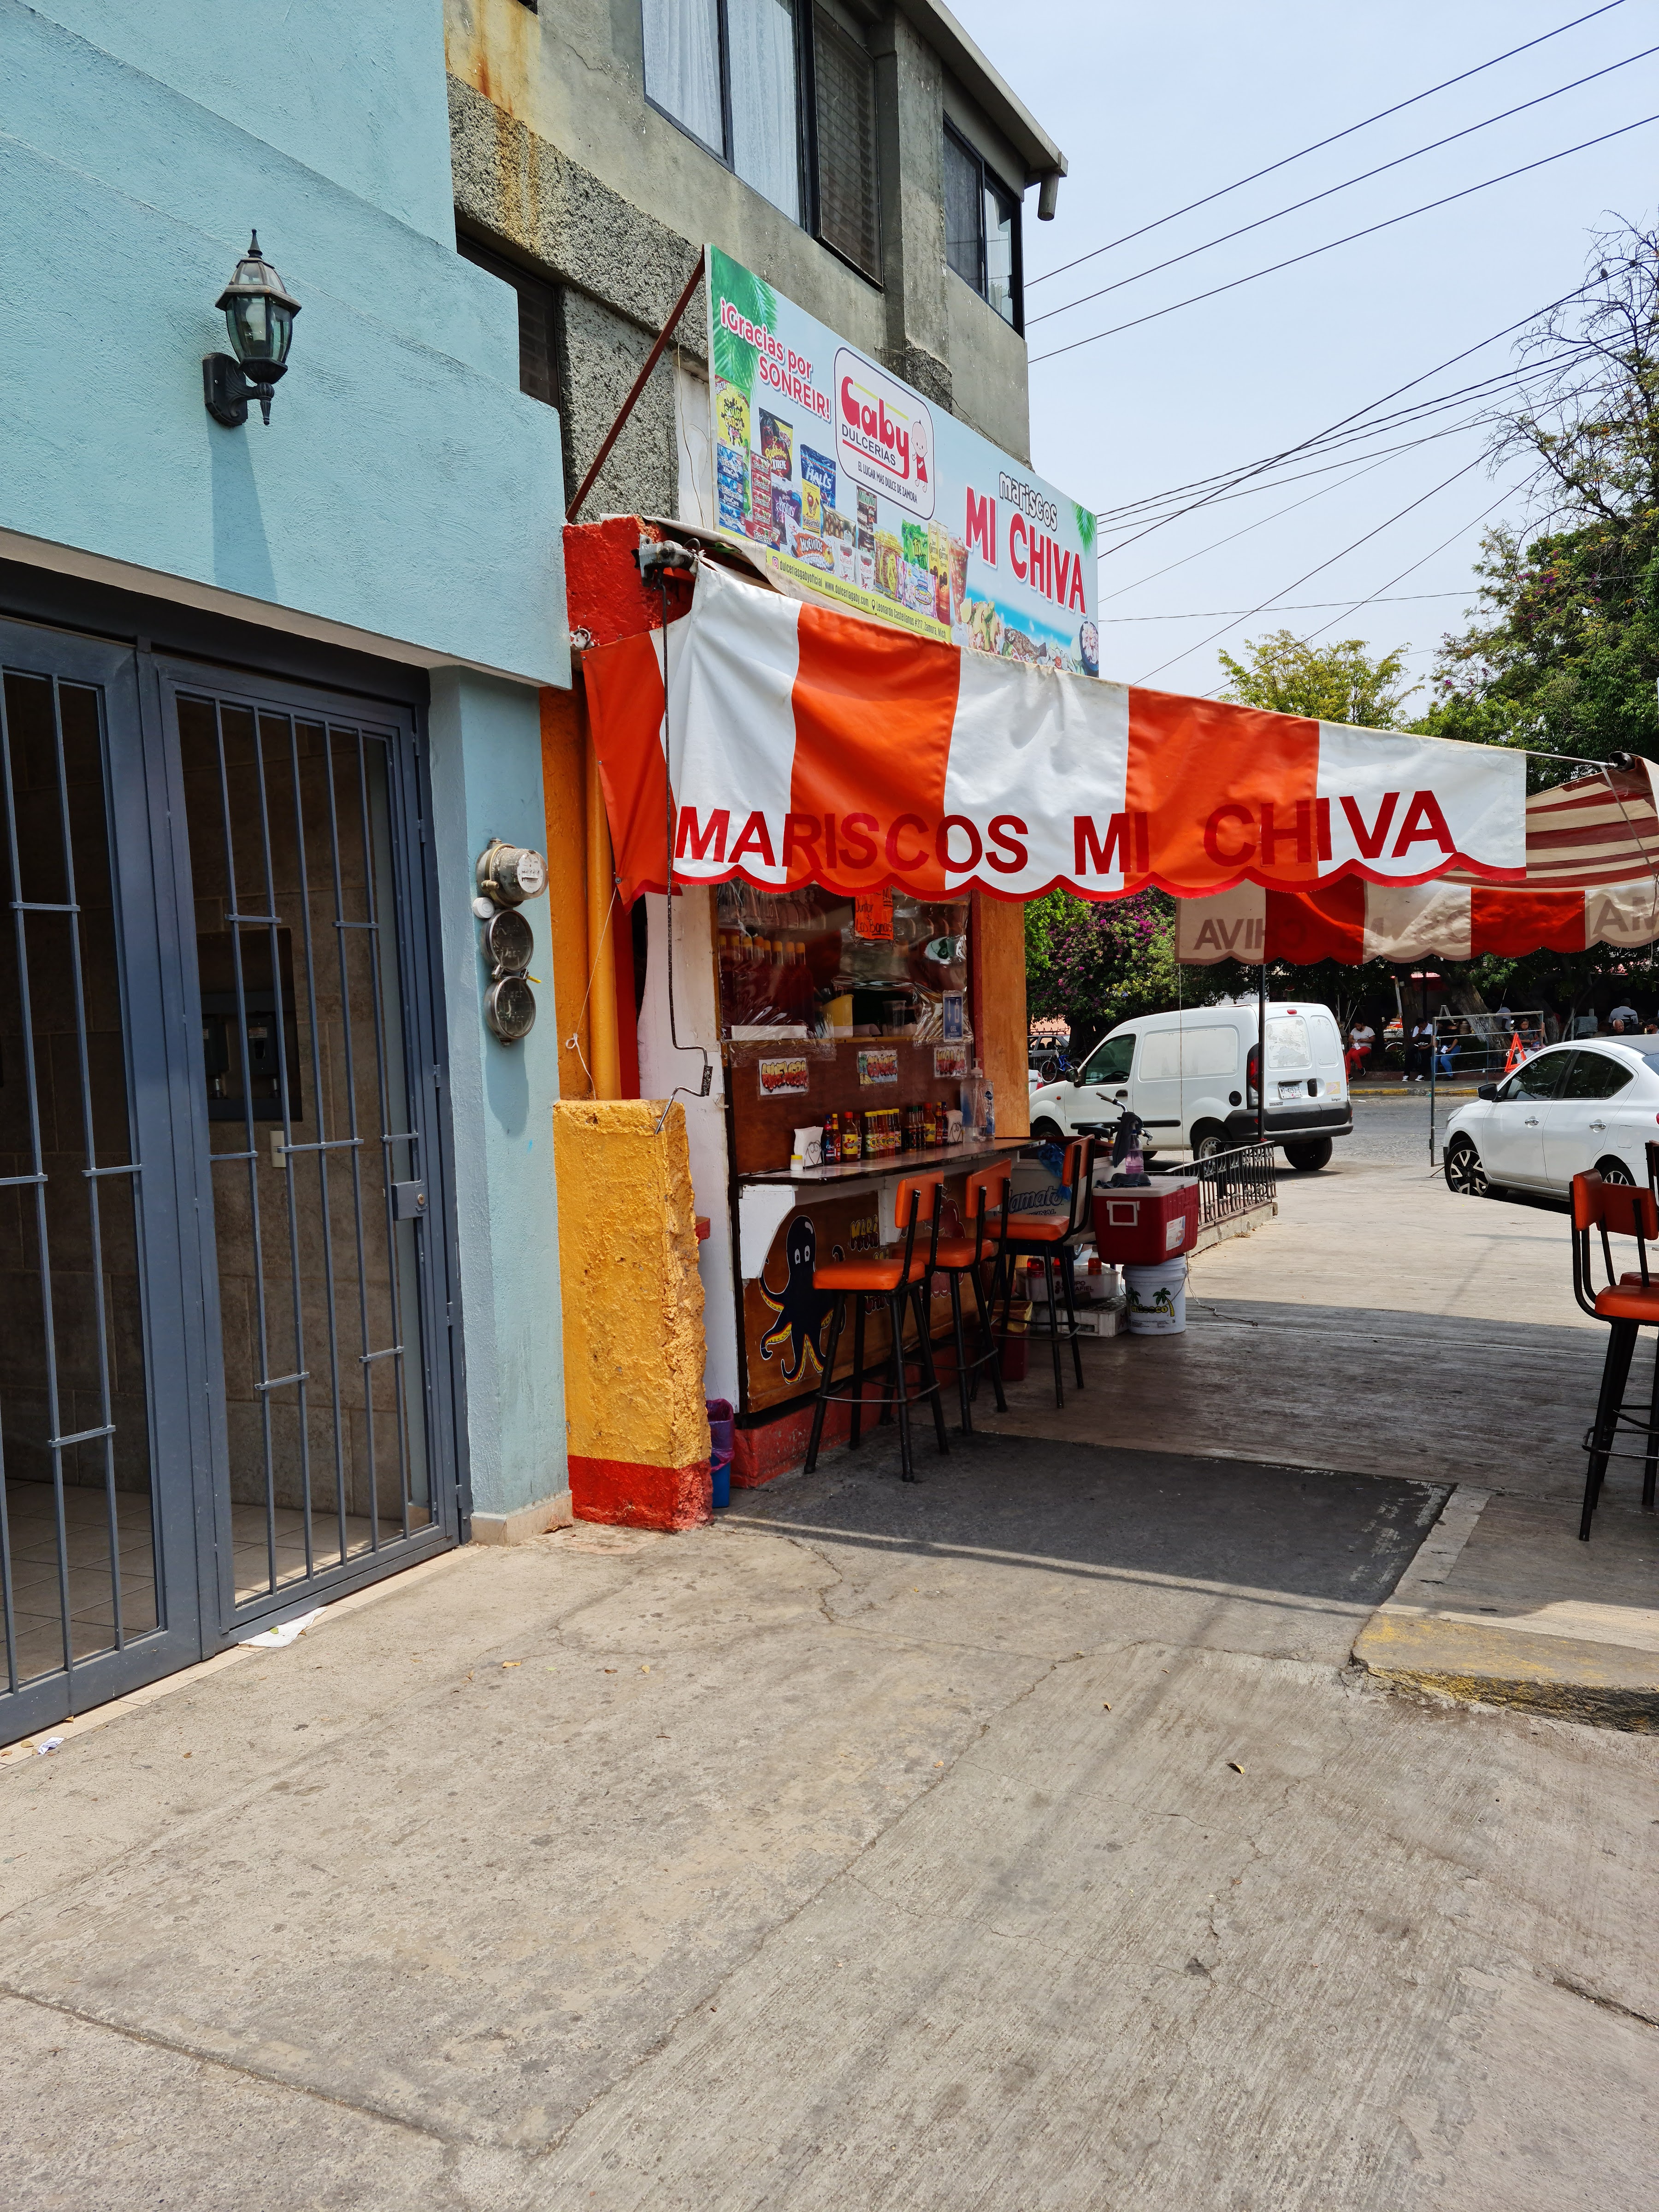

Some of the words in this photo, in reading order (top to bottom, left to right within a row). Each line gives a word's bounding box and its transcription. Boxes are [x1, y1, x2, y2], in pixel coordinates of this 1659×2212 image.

[720, 297, 784, 361] ¡Gracias
[788, 348, 813, 380] por
[759, 356, 831, 421] SONREIR!
[725, 406, 741, 420] SOUR
[725, 416, 743, 431] PATCH
[841, 376, 909, 479] Gaby
[779, 430, 791, 449] NUEVO
[842, 424, 896, 466] DULCERIAS
[721, 457, 738, 472] Trident
[753, 461, 768, 474] Trident
[772, 458, 786, 470] XTREME
[754, 479, 769, 491] Trident
[806, 466, 832, 489] HALLS
[858, 461, 862, 472] EL
[863, 464, 876, 480] LUGAR
[885, 477, 896, 491] DULCE
[897, 484, 902, 495] DE
[902, 486, 917, 503] ZAMORA
[721, 485, 739, 500] Trident
[754, 495, 769, 508] Trident
[999, 472, 1057, 532] mariscos
[724, 513, 738, 524] Trident
[755, 512, 770, 524] Trident
[753, 531, 772, 545] Trident
[800, 537, 823, 552] HUEVITOS
[967, 485, 997, 568] MI
[1010, 513, 1086, 616] CHIVA
[840, 555, 853, 566] Raffaello
[780, 560, 822, 587] dulceriasgabyoficial
[825, 580, 869, 607] www.dulceriagaby.com
[876, 601, 893, 615] Leonardo
[894, 609, 914, 625] Castellanos
[915, 618, 924, 631] #217,
[924, 622, 938, 637] Zamora,
[938, 626, 947, 639] Mich.
[915, 590, 930, 603] Bianchi
[675, 806, 1028, 873] MARISCOS
[1074, 811, 1150, 875] MI
[1204, 790, 1455, 867] CHIVA
